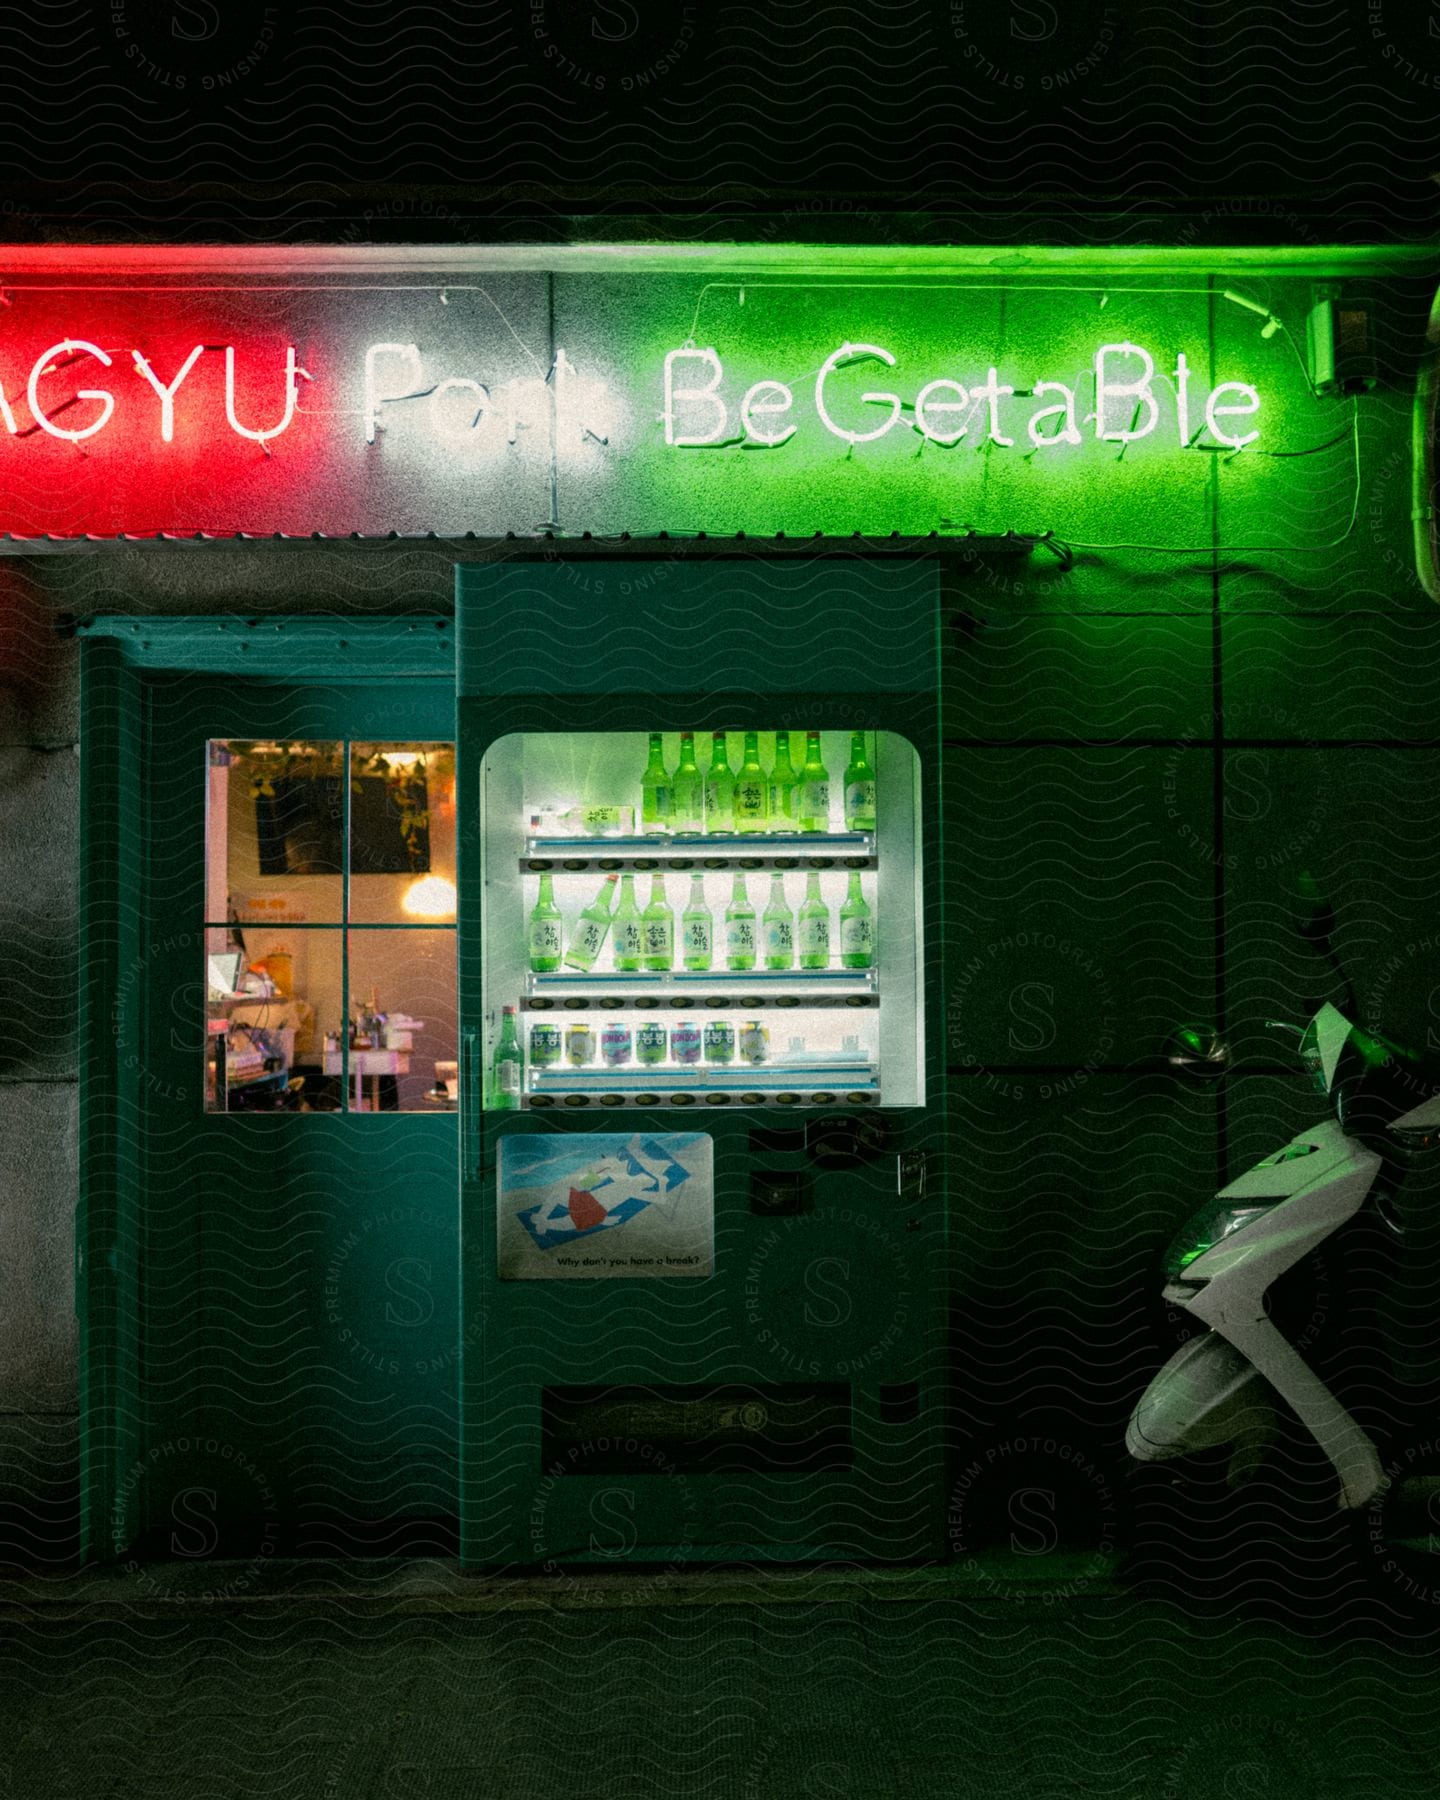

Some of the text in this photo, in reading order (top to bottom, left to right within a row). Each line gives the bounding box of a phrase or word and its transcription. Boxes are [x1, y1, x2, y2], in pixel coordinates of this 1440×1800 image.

[647, 926, 667, 938] 좋은
[557, 1257, 579, 1268] Why
[583, 1257, 607, 1266] don't
[609, 1258, 628, 1268] you
[630, 1257, 654, 1266] have
[665, 1256, 700, 1266] break?
